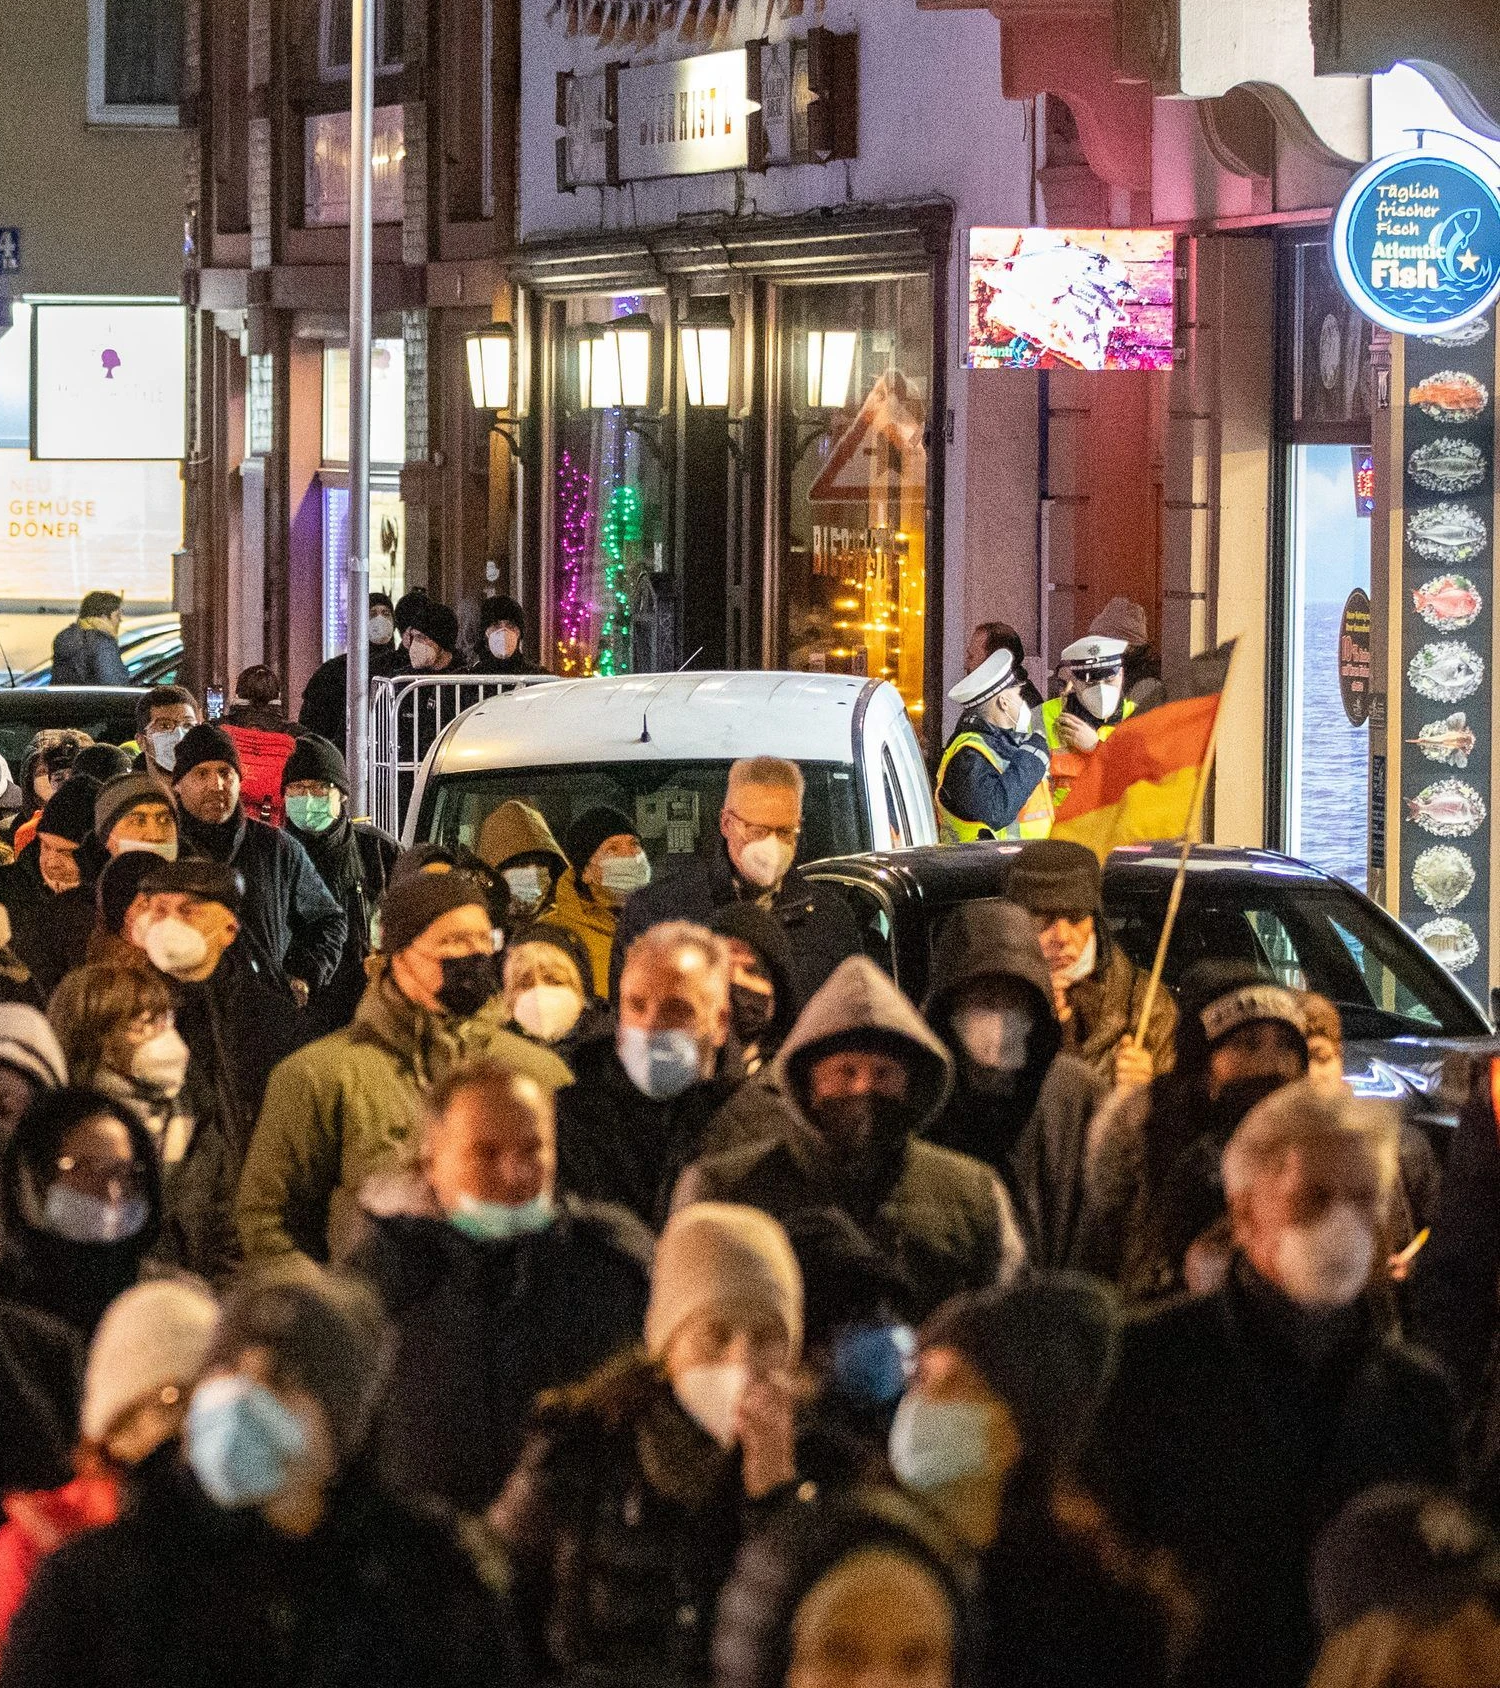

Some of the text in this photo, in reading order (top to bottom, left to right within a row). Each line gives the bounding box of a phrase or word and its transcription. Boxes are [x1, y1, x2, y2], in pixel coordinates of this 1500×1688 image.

[1376, 182, 1440, 203] Täglich
[1376, 200, 1441, 221] frischer
[1376, 219, 1419, 236] Fisch
[1371, 241, 1447, 260] Atlantic
[1371, 259, 1439, 289] Fish
[9, 497, 96, 517] GEMÜSE
[9, 519, 79, 538] DÖNER
